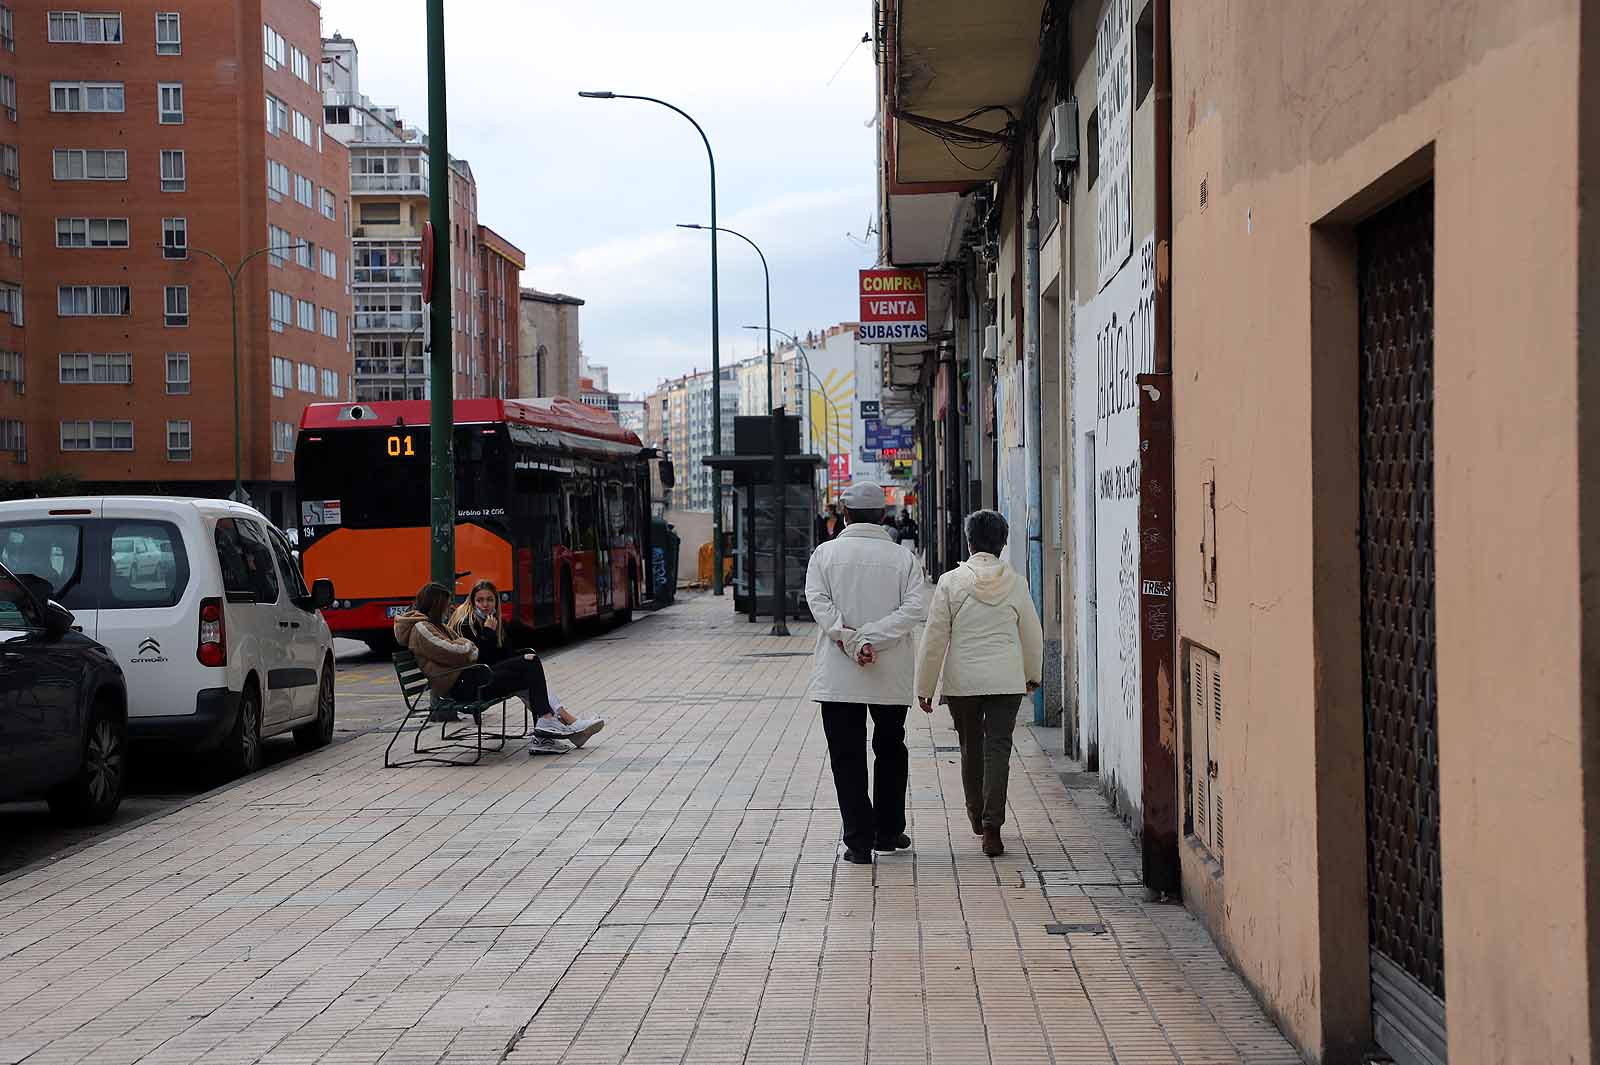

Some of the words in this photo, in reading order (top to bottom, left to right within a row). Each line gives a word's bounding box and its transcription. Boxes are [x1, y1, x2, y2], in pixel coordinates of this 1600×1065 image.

[863, 276, 921, 291] COMPRA
[869, 301, 916, 315] VENTA
[860, 325, 927, 338] SUBASTAS
[387, 435, 415, 456] 01
[303, 527, 315, 537] 194
